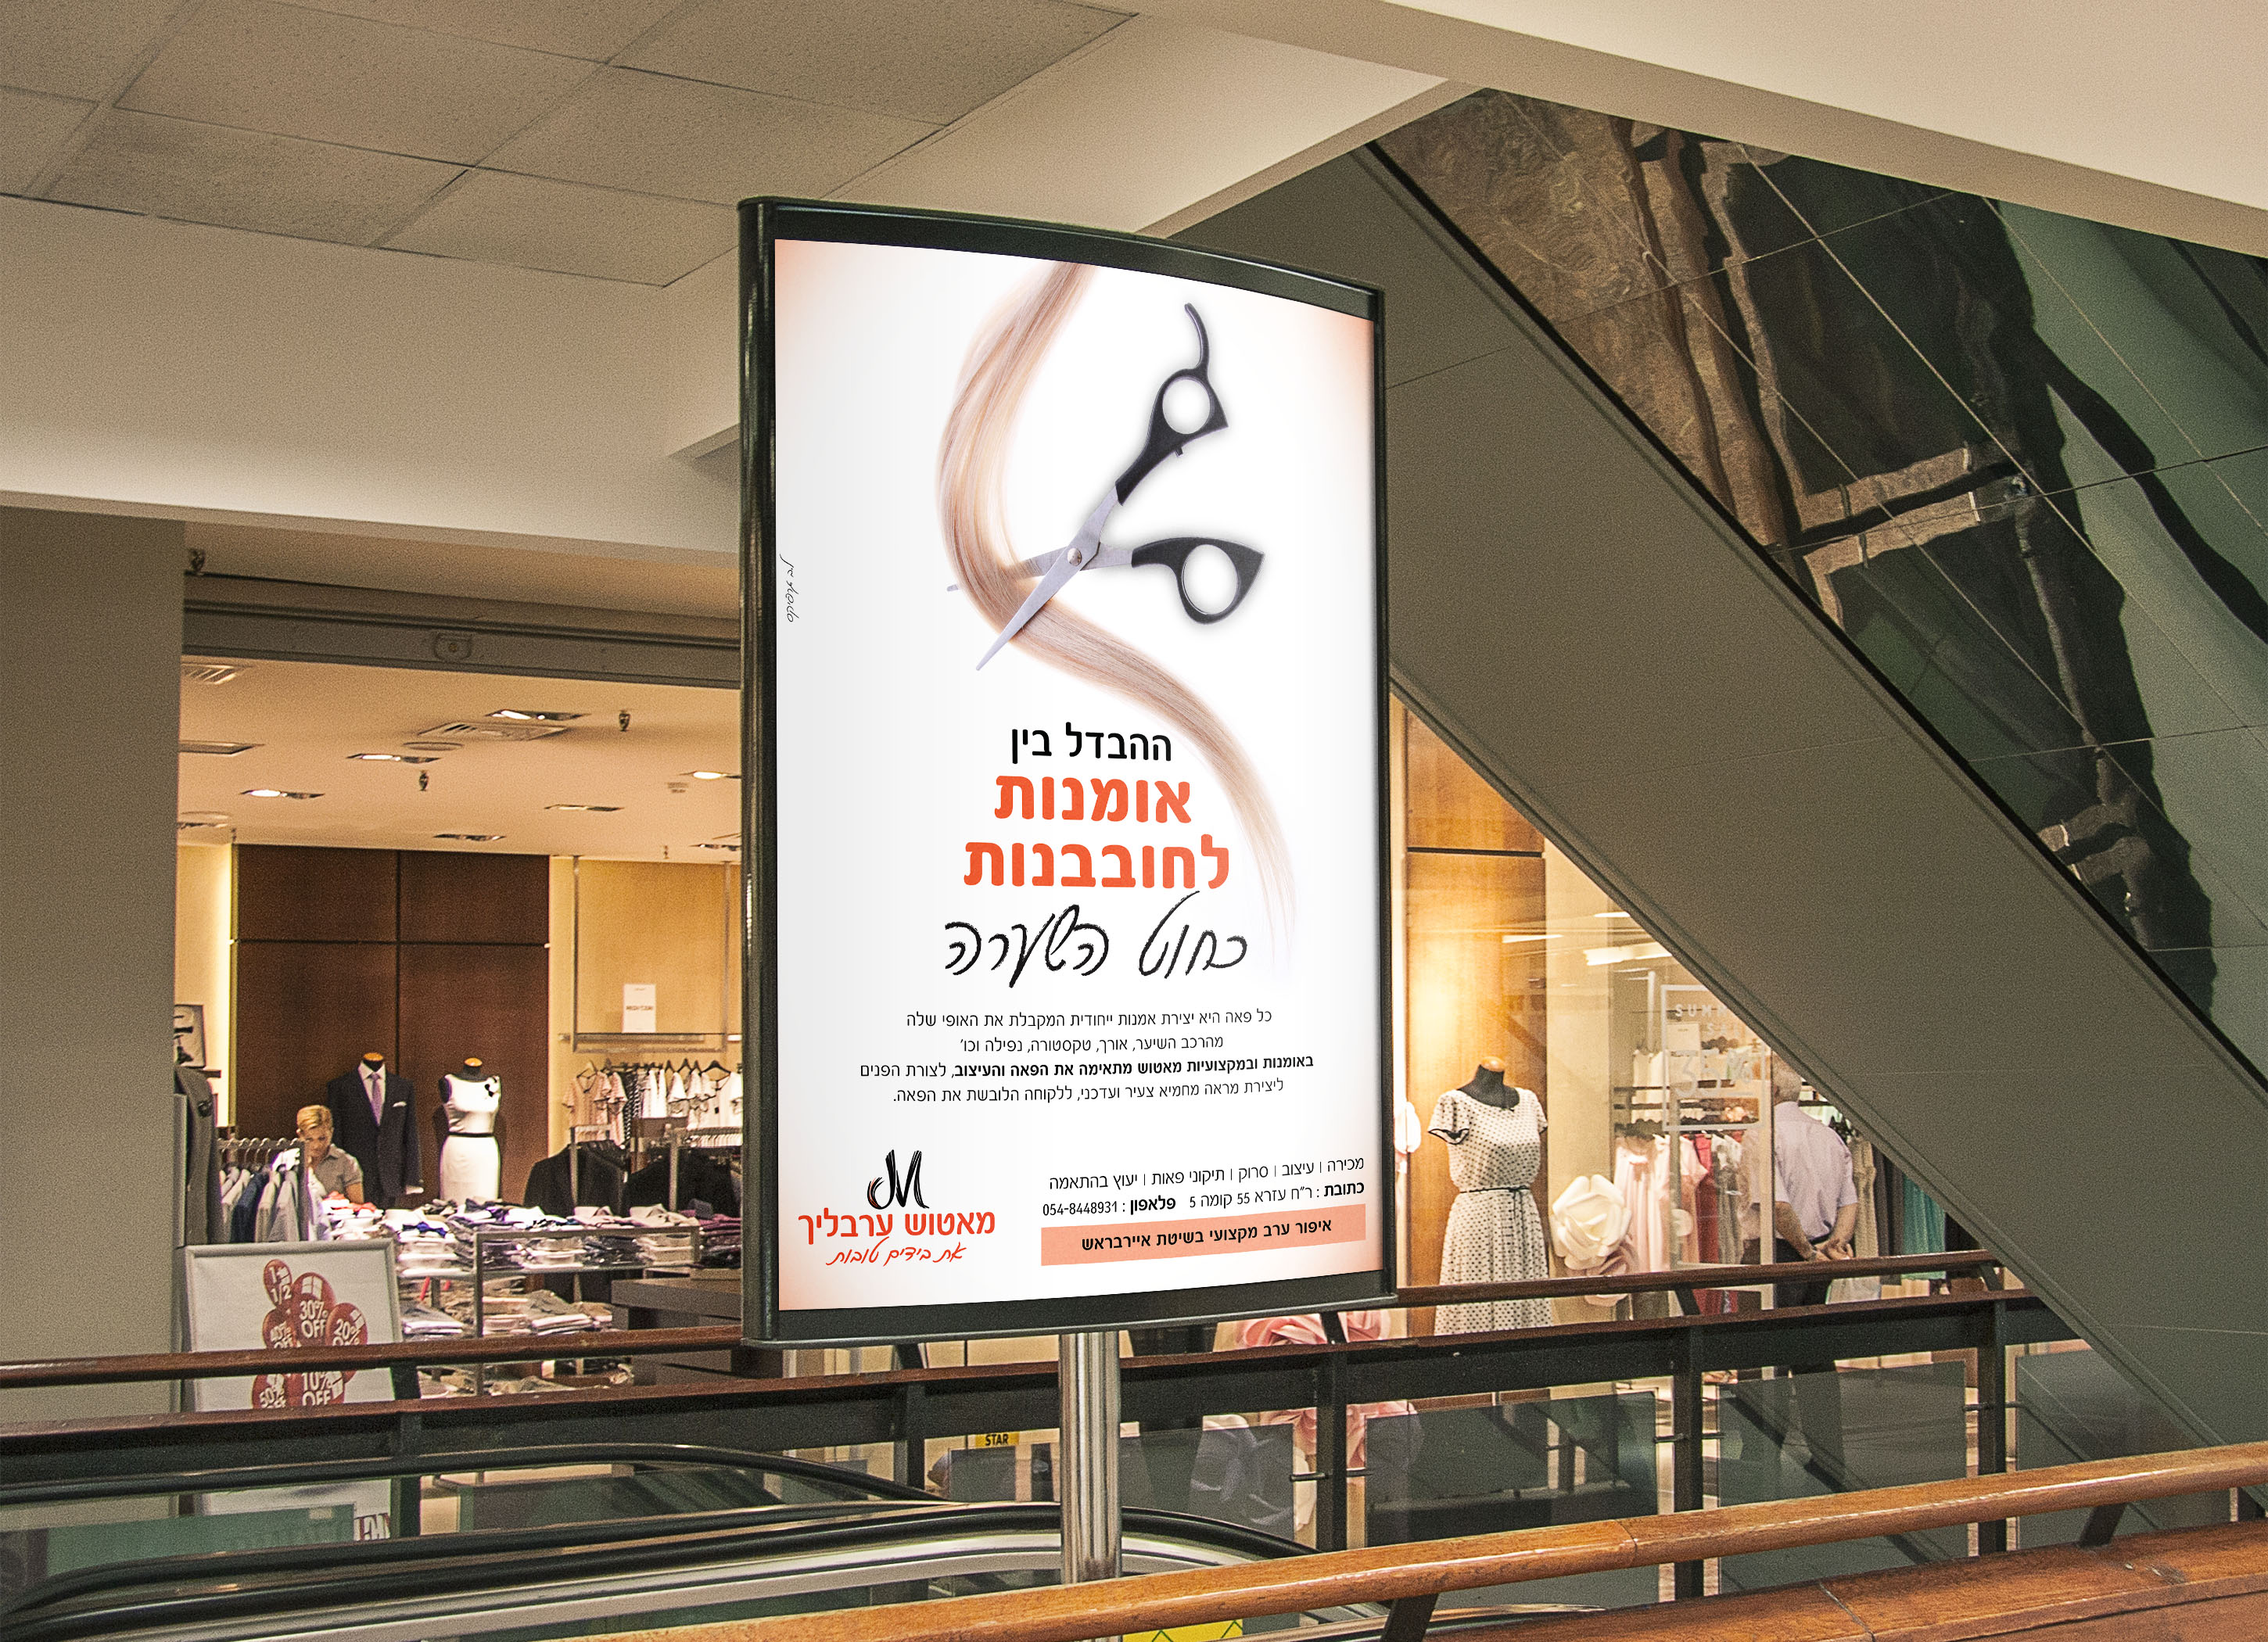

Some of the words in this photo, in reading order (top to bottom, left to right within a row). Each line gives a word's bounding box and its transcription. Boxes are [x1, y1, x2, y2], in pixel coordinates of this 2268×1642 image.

[1011, 728, 1053, 765] בין
[1065, 721, 1172, 762] ההבדל
[994, 775, 1192, 824] אומנות
[964, 834, 1229, 889] לחובבנות
[1138, 890, 1248, 980] כחוט
[944, 904, 1110, 989] השערה
[906, 1010, 936, 1027] שלה
[942, 1014, 978, 1027] האופי
[983, 1015, 1003, 1027] את
[1008, 1011, 1065, 1031] המקבלת
[1070, 1014, 1113, 1027] ייחודית
[1118, 1013, 1156, 1026] אמנות
[1161, 1013, 1194, 1025] יצירת
[1199, 1012, 1220, 1024] היא
[1226, 1011, 1252, 1024] פאה
[1256, 1008, 1272, 1022] כל
[985, 1036, 1023, 1052] נפילה
[1027, 1039, 1091, 1055] טקסטורה,
[1096, 1038, 1128, 1054] אורך,
[1132, 1038, 1176, 1052] השיער,
[1181, 1036, 1223, 1049] מהרכב
[860, 1064, 900, 1077] הפנים
[905, 1061, 946, 1077] לצורת
[1010, 1064, 1049, 1077] הפאה
[1053, 1064, 1074, 1076] את
[1078, 1063, 1132, 1076] מתאימה
[1137, 1061, 1182, 1074] מאטוש
[1186, 1058, 1258, 1074] ובמקצועיות
[1262, 1056, 1314, 1069] באומנות
[951, 1064, 1005, 1079] והעיצוב,
[1125, 1086, 1154, 1099] צעיר
[1159, 1084, 1200, 1098] מחמיא
[1204, 1083, 1239, 1095] מראה
[1243, 1077, 1283, 1094] ליצירת
[893, 1089, 936, 1102] הפאה.
[941, 1089, 961, 1102] את
[966, 1086, 1019, 1102] הלובשת
[1025, 1085, 1072, 1104] ללקוחה
[1077, 1087, 1120, 1102] ועדכני,
[1282, 1162, 1315, 1177] עיצוב
[1327, 1157, 1364, 1173] מכירה
[1050, 1175, 1109, 1190] בהתאמה
[1113, 1174, 1138, 1191] יעוץ
[1151, 1171, 1185, 1185] פאות
[1189, 1169, 1225, 1185] תיקוני
[1238, 1166, 1269, 1184] סרוק
[1254, 1188, 1287, 1203] עזרא
[1323, 1181, 1365, 1197] כתובת
[1130, 1194, 1176, 1216] פלאפון
[1190, 1196, 1196, 1208] 5
[1200, 1193, 1233, 1210] קומה
[1236, 1192, 1251, 1205] 55
[1042, 1200, 1118, 1217] 054-8448931
[798, 1207, 893, 1246] ערבליך
[904, 1211, 996, 1236] מאטוש
[1263, 1223, 1290, 1237] ערב
[1295, 1219, 1332, 1234] איפור
[1156, 1231, 1204, 1246] בשיטת
[1209, 1226, 1258, 1243] מקצועי
[825, 1235, 890, 1266] טובות
[1082, 1235, 1151, 1251] איירבראש
[883, 1246, 931, 1267] בידים
[932, 1242, 967, 1264] את
[271, 1285, 292, 1305] 1/2
[300, 1300, 328, 1320] 30%
[301, 1319, 326, 1338] OFF
[334, 1318, 361, 1345] 20%
[301, 1372, 333, 1390] 10%
[302, 1389, 331, 1406] OFF
[985, 1433, 1009, 1446] STAR
